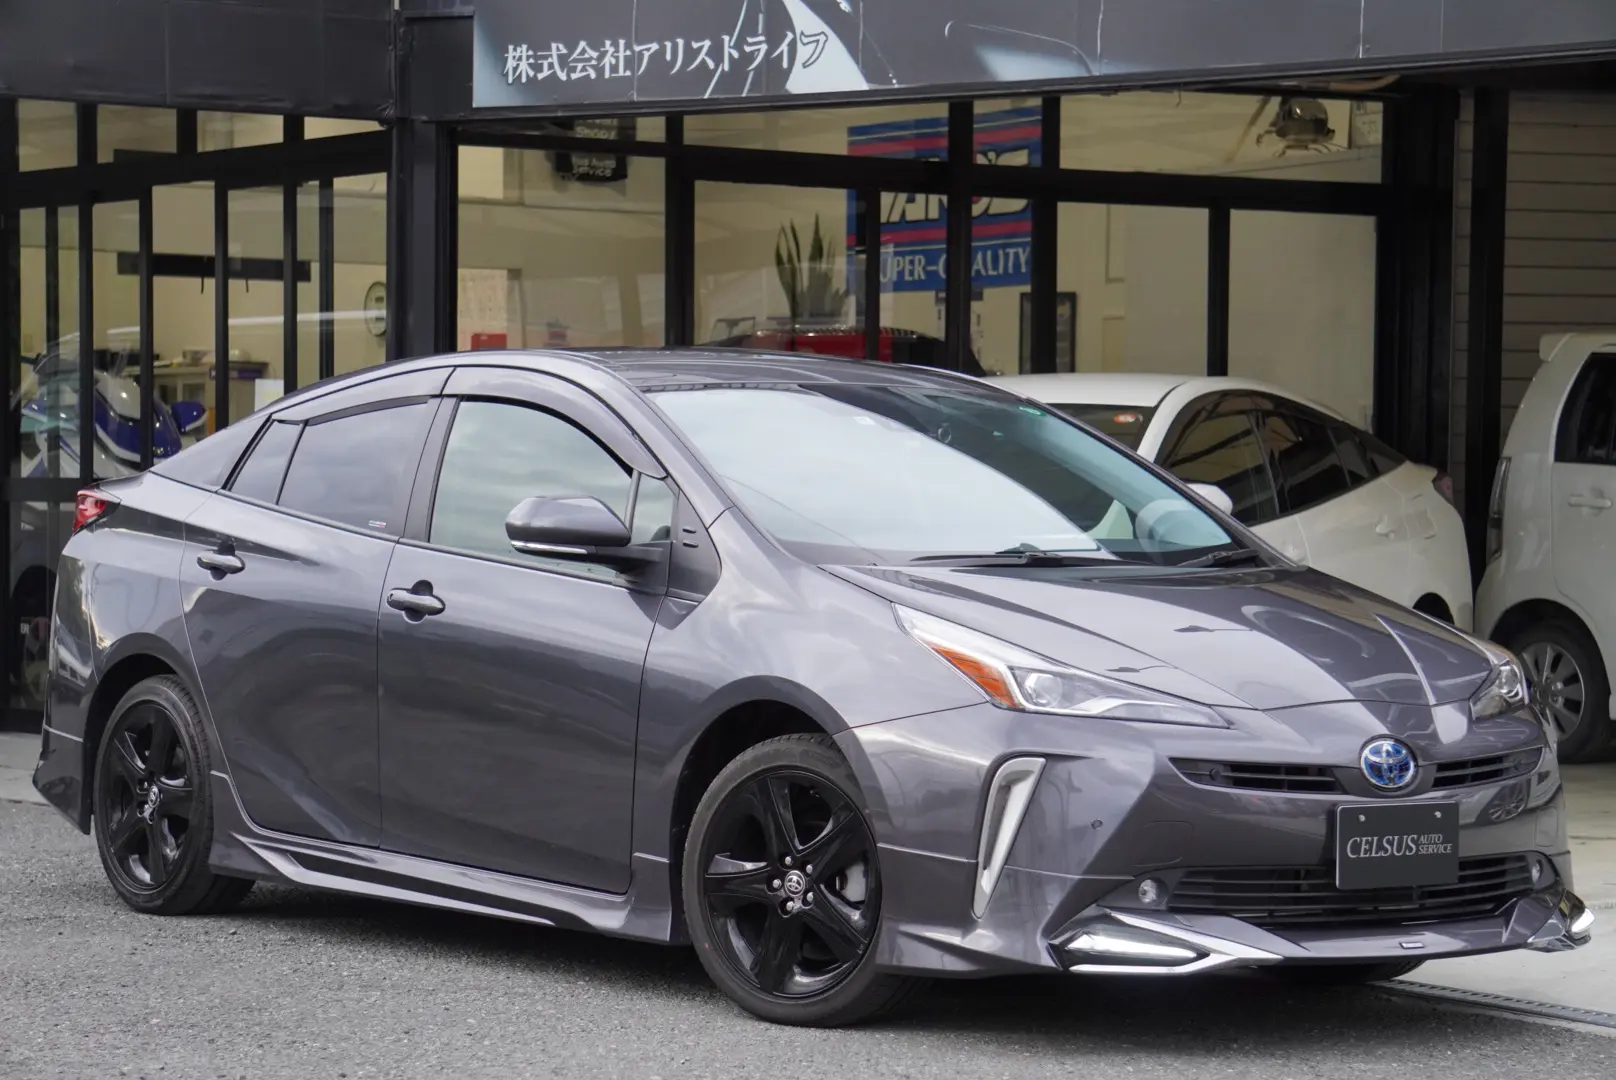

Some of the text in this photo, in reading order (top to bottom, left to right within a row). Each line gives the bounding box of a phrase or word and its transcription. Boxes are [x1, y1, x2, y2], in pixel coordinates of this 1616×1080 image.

[503, 31, 829, 84] 株式会社アリストライフ
[879, 247, 1029, 283] UPER-ALITY
[1346, 833, 1443, 858] CELSUS AUTO
[1418, 843, 1452, 854] SERVICE
